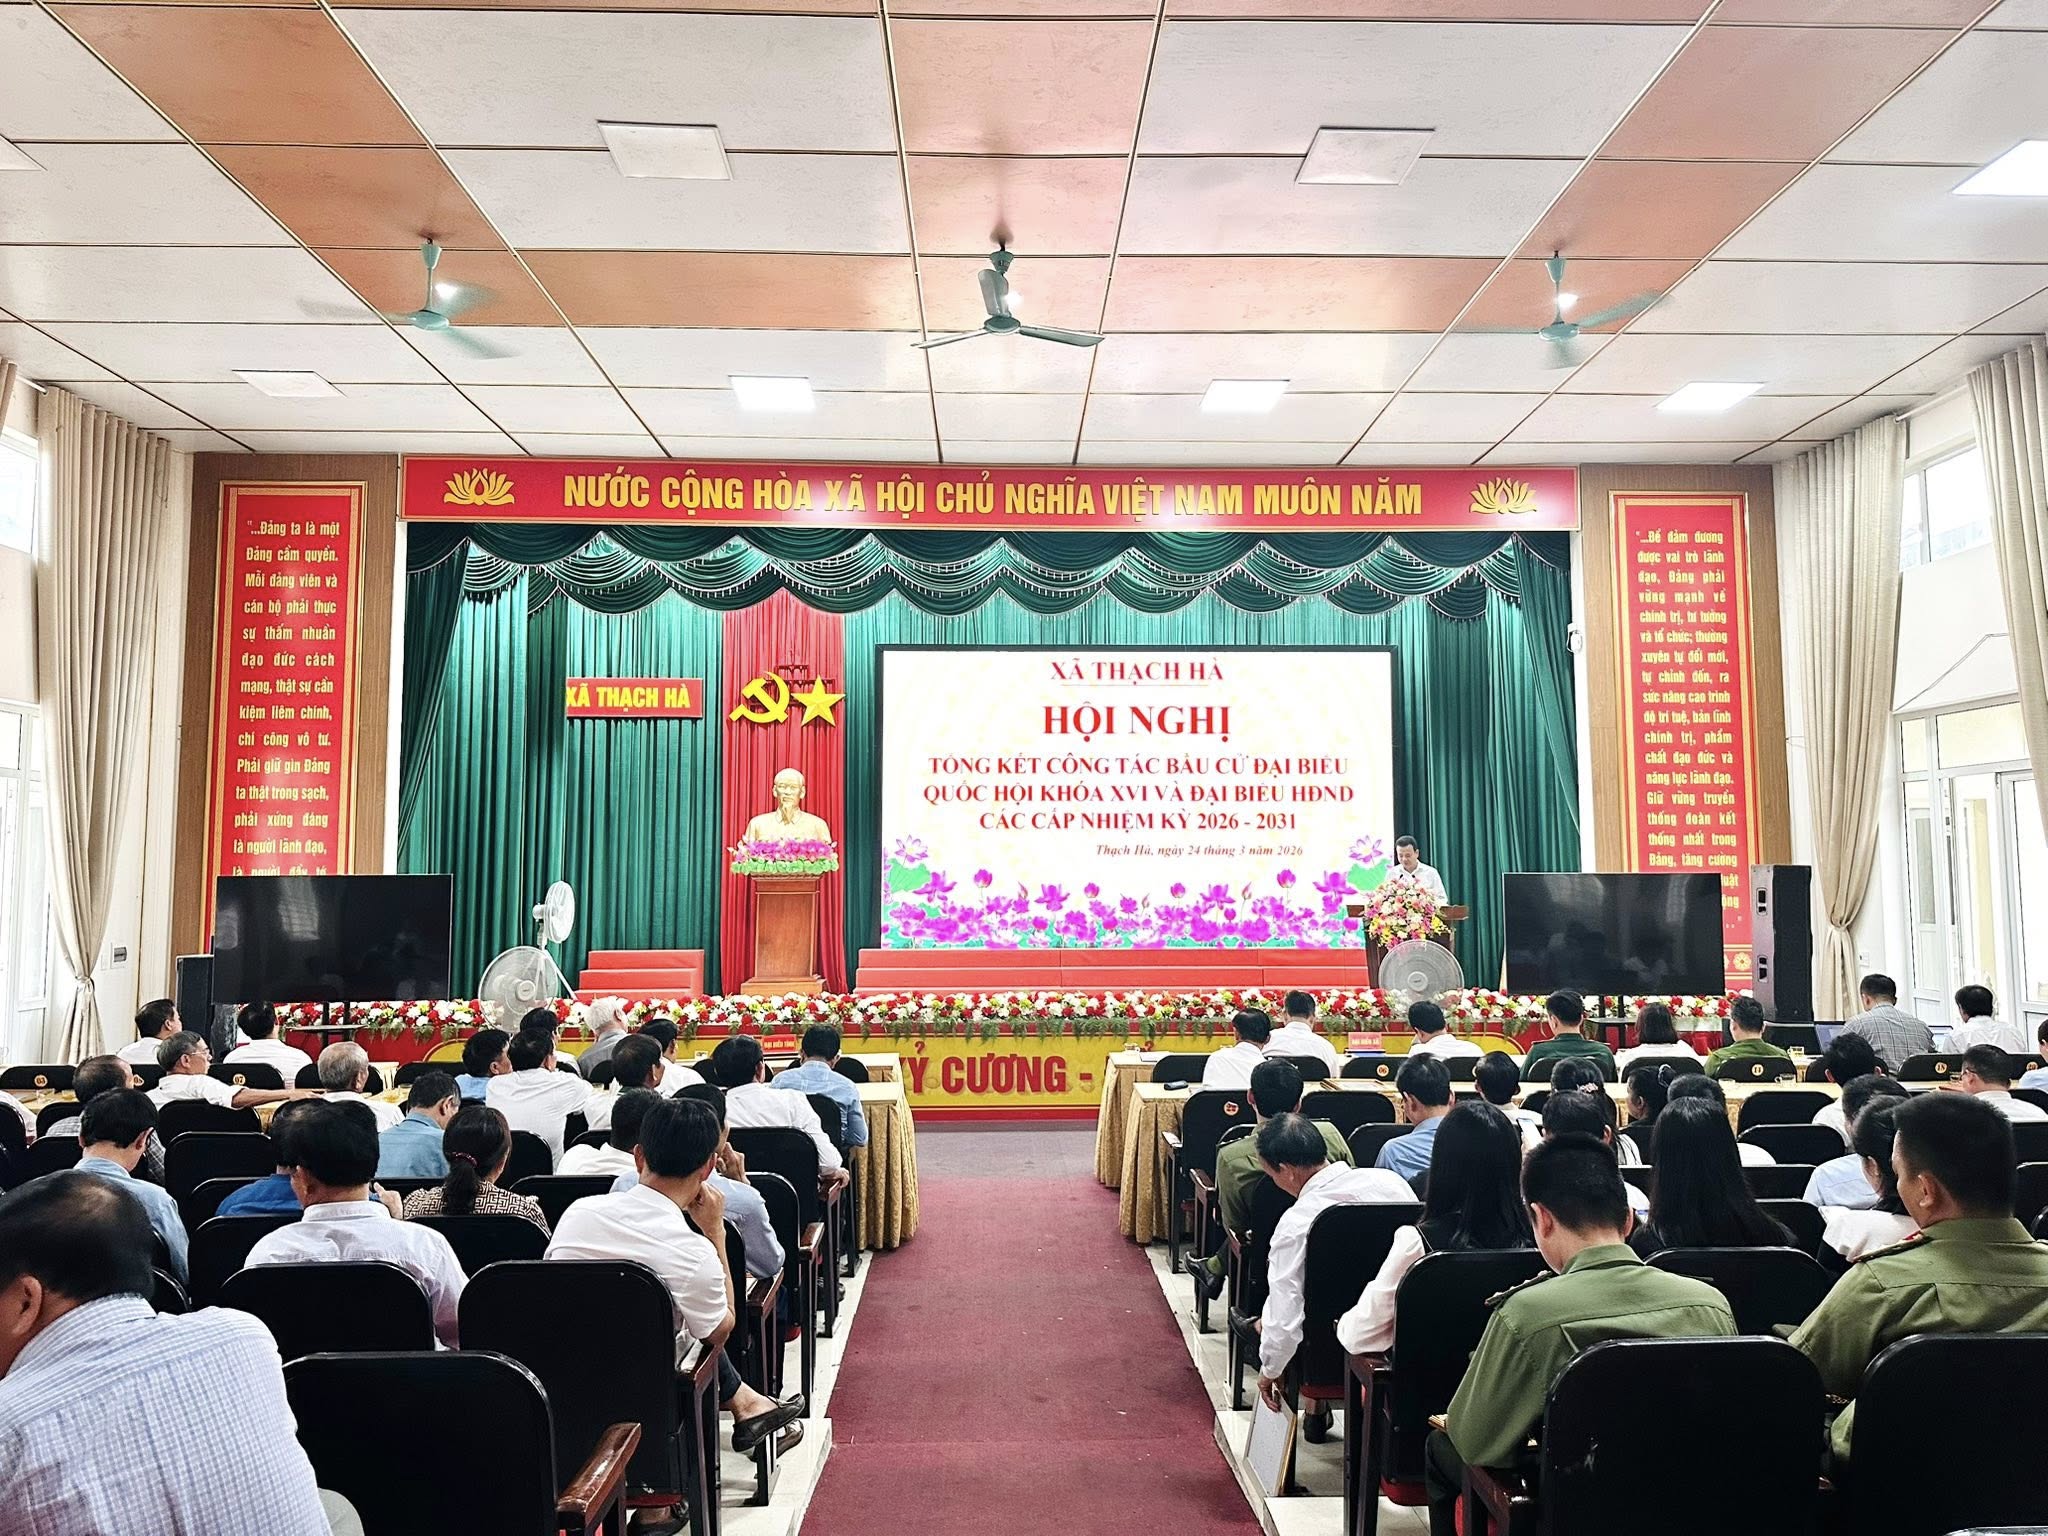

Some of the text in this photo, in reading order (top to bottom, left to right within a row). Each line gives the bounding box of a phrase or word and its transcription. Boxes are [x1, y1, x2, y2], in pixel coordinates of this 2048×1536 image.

[564, 467, 1423, 521] NƯỚC CỘNG HÒA XÃ HỘI CHỦ NGHĨA VIỆT NAM MUÔN NĂM
[291, 523, 301, 535] ta
[305, 522, 317, 535] là
[319, 523, 340, 537] một
[246, 546, 338, 563] Đảng cầm quyền.
[245, 574, 337, 589] Mỗi đảng viên và
[243, 598, 336, 616] cán bộ phải thực
[242, 625, 336, 641] sự thấm nhuần
[241, 652, 335, 668] đạo đức cách
[1051, 657, 1225, 685] XÃ THẠCH HÀ
[240, 679, 333, 694] mạng, thật sự cần
[567, 682, 692, 712] XÃ THẠCH HÀ
[239, 706, 332, 722] kiệm liêm chính,
[1042, 702, 1231, 743] HỘI NGHỊ
[238, 732, 330, 748] chí công vô tư.
[237, 759, 331, 774] Phải giữ gìn Đảng
[928, 752, 1348, 778] TỔNG KẾT CÔNG TÁC BẦU CỬ ĐẠI BIỂU
[236, 786, 329, 800] ta thật trong sạch,
[924, 781, 1354, 806] QUỐC HỘI KHÓA XVI VÀ ĐẠI BIỂU HĐND
[233, 812, 329, 828] phải xứng đáng
[979, 809, 1026, 829] CÁC
[1031, 808, 1075, 829] CẤP
[1081, 810, 1154, 833] NHIỆM
[1161, 809, 1191, 829] KỲ
[1197, 812, 1239, 829] 2026
[1256, 812, 1296, 829] 2031
[233, 841, 326, 855] là người lãnh đạo,
[1096, 844, 1303, 858] Thạch Hà, ngày 24 tháng 3 năm 2026
[941, 1053, 1068, 1094] CƯƠNG
